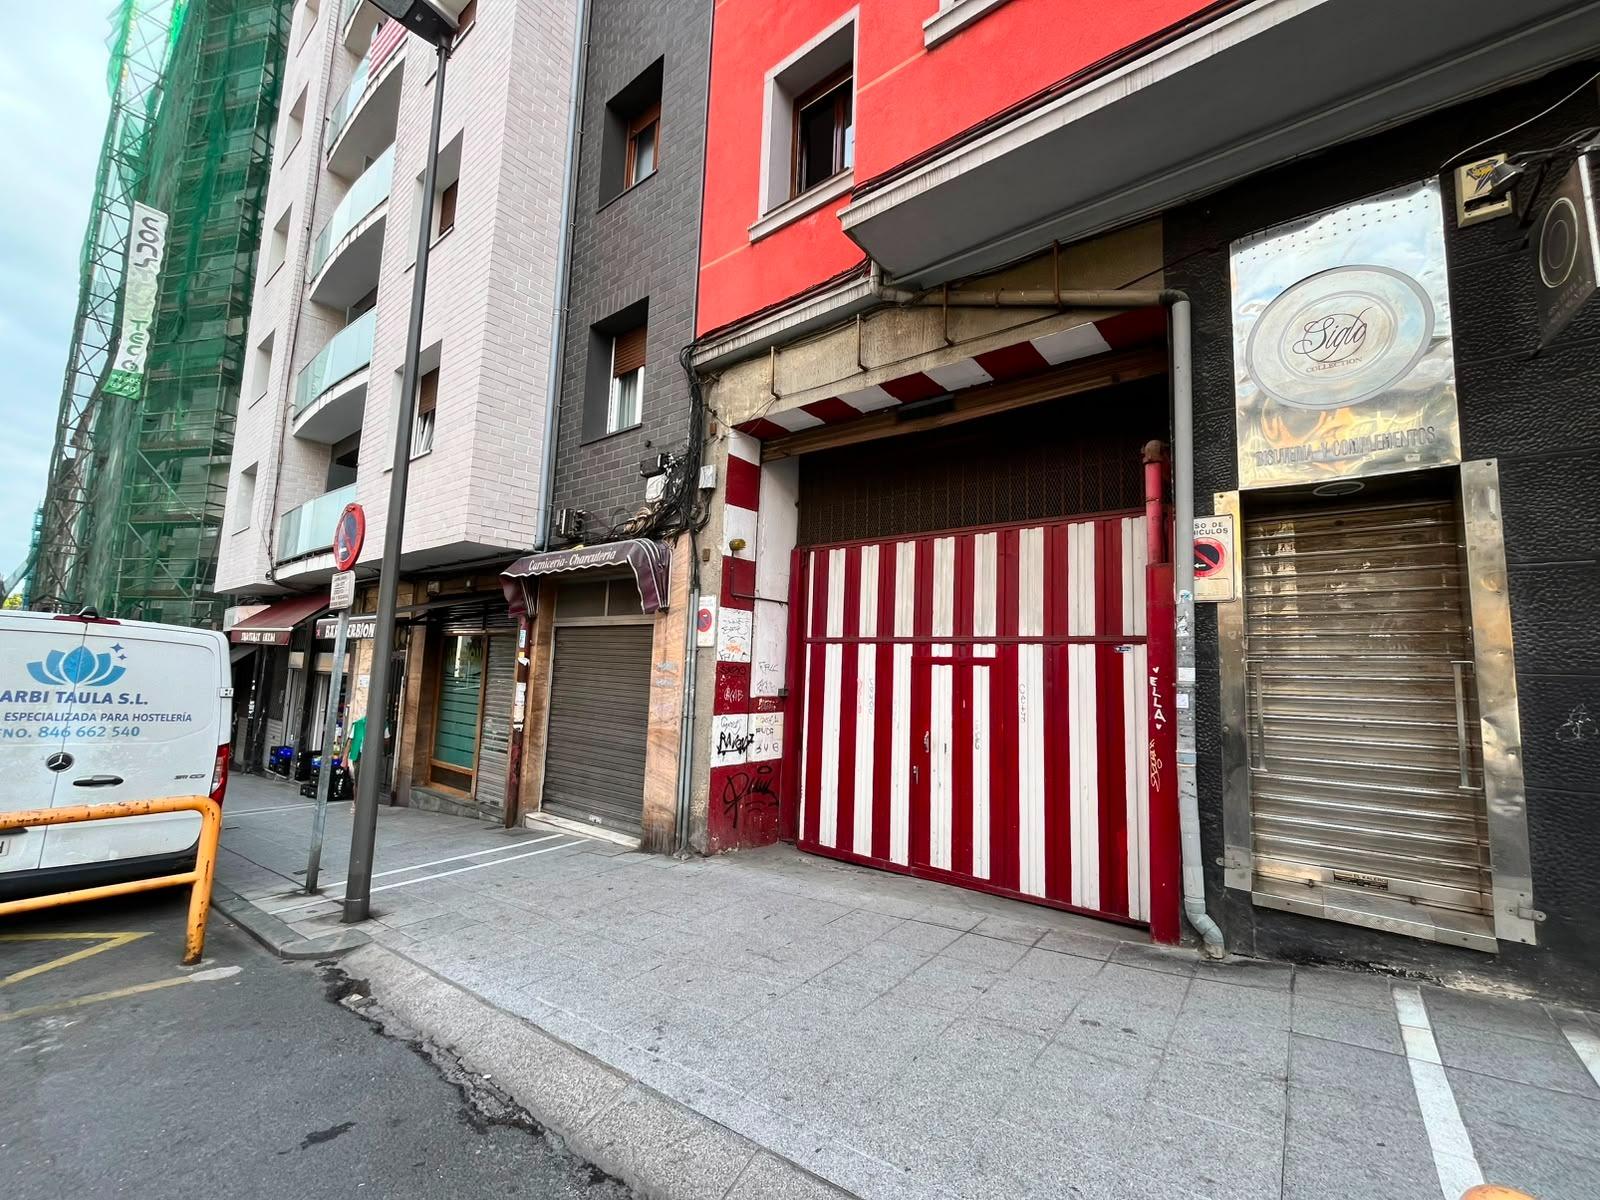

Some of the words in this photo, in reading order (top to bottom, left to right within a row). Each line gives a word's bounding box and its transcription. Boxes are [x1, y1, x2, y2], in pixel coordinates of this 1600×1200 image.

[1292, 307, 1373, 362] Siglo
[1306, 357, 1363, 373] COLLECTION
[56, 691, 113, 704] TAULA
[117, 693, 148, 705] S.L.
[1149, 676, 1167, 722] ELLA
[4, 712, 97, 722] ESPECIALIZADA
[100, 713, 129, 722] PARA
[132, 711, 192, 722] HOSTELERÍA
[38, 726, 71, 738] 846
[76, 726, 106, 738] 662
[111, 726, 140, 737] 540
